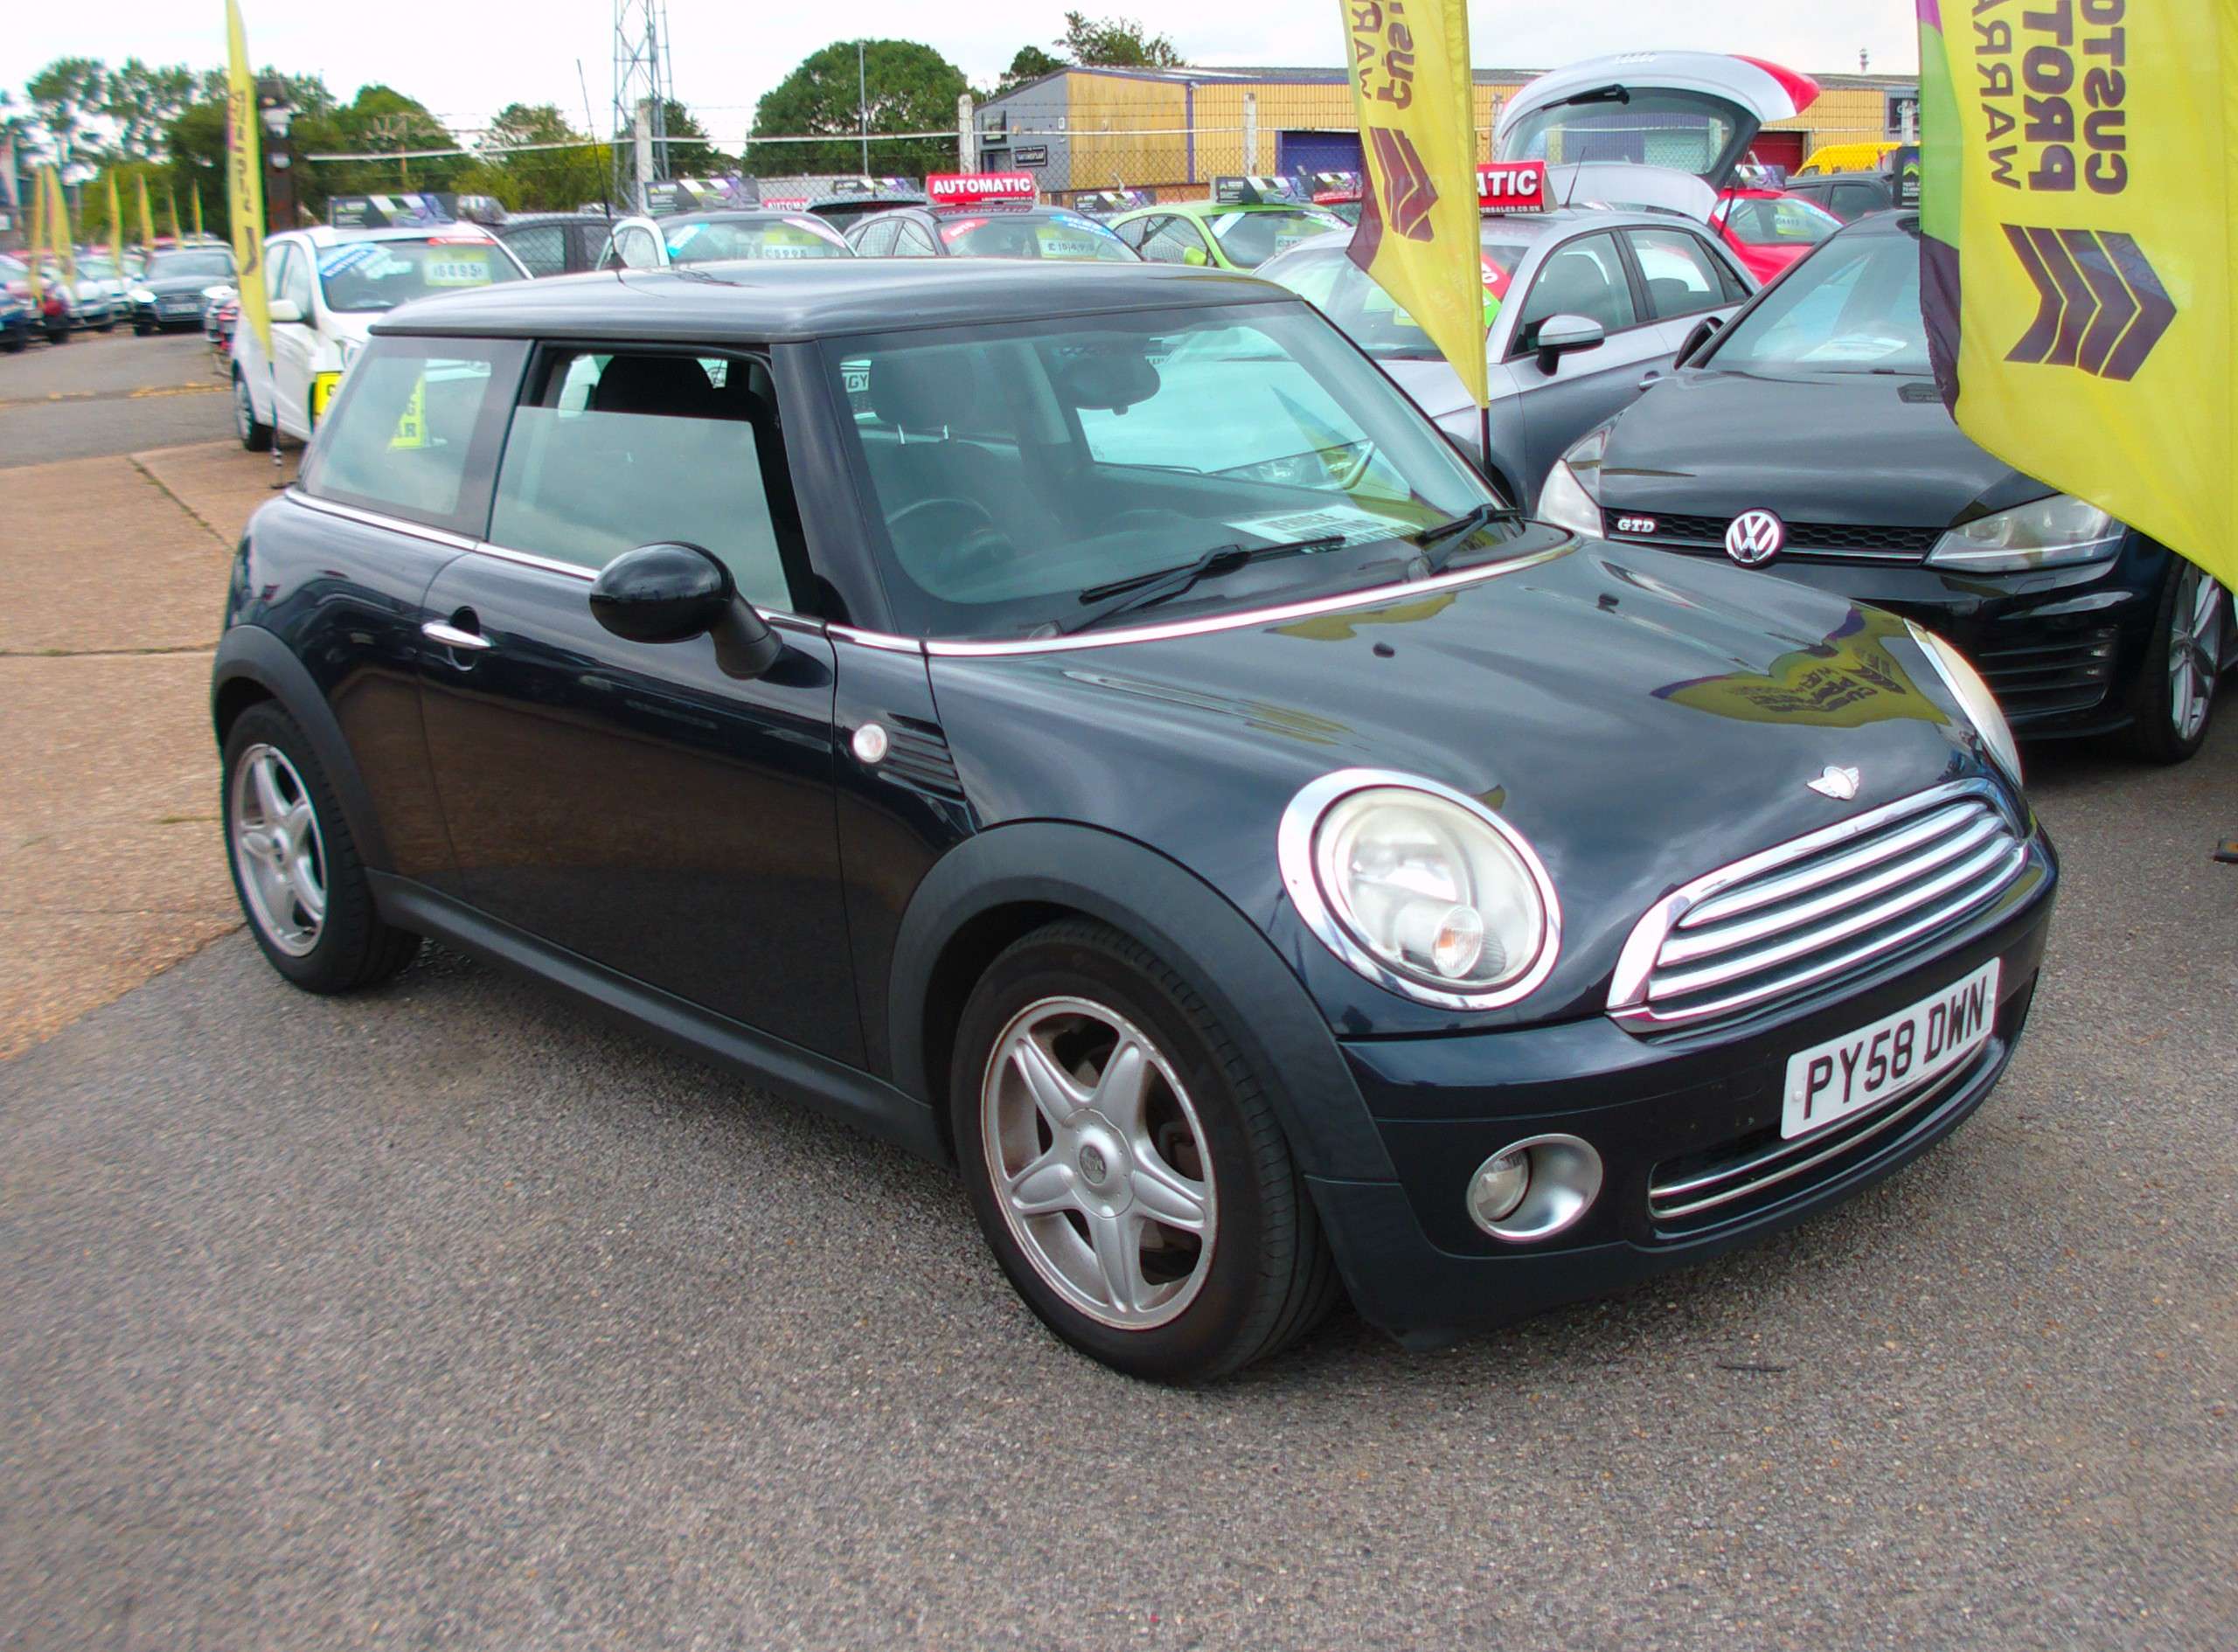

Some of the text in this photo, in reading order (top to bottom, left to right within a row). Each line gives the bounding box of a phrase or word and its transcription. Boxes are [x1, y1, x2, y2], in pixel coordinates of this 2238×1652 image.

[933, 177, 1032, 195] AUTOMATIC
[1616, 517, 1657, 534] GTD
[1803, 975, 1987, 1121] PY58 DWN
